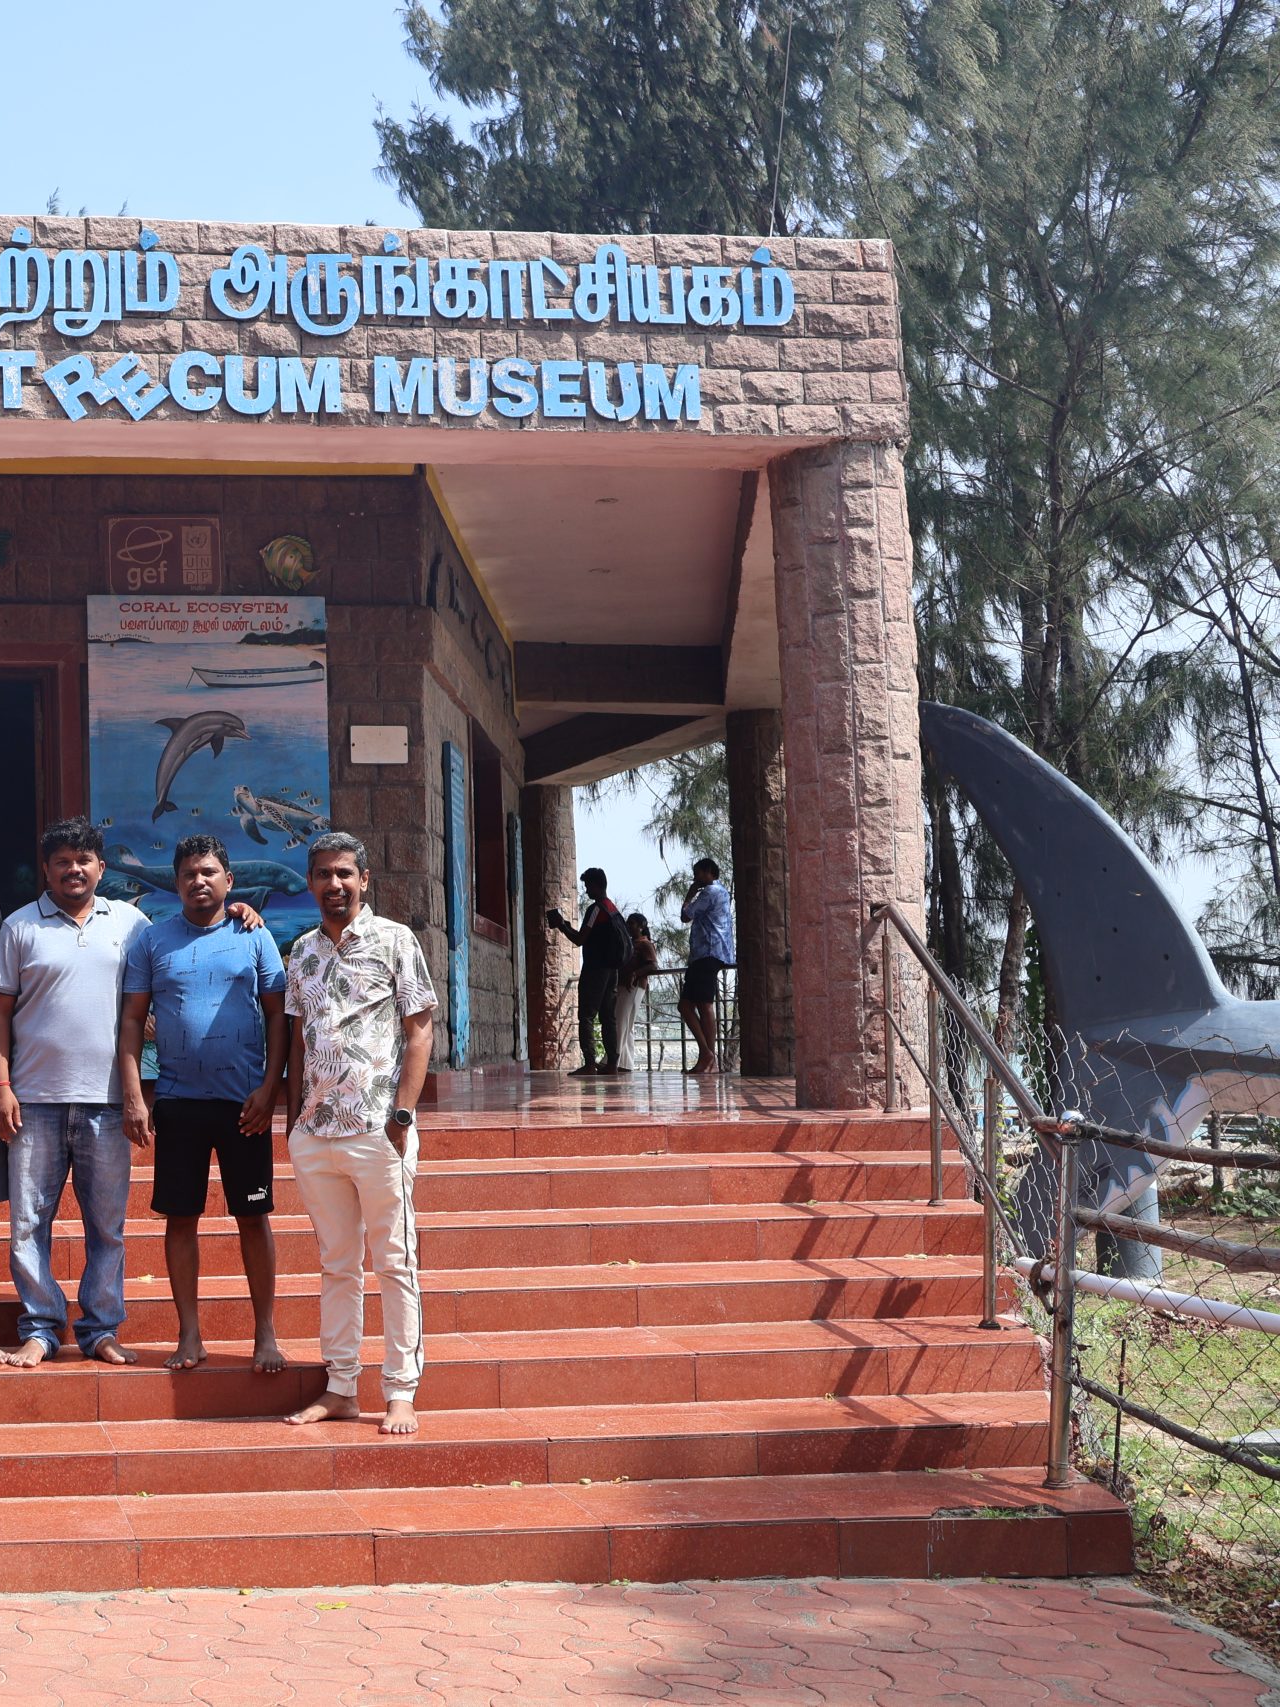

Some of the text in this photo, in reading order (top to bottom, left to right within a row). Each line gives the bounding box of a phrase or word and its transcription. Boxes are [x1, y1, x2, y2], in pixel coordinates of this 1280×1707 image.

[208, 230, 797, 337] அருங்காட்சியகம்
[167, 349, 342, 416] CUM
[371, 355, 704, 424] MUSEUM
[127, 561, 167, 590] gef
[119, 602, 289, 614] CORAL ECOSYSTEM
[120, 616, 189, 634] பவளப்பாறை
[247, 1192, 266, 1202] PUMA
